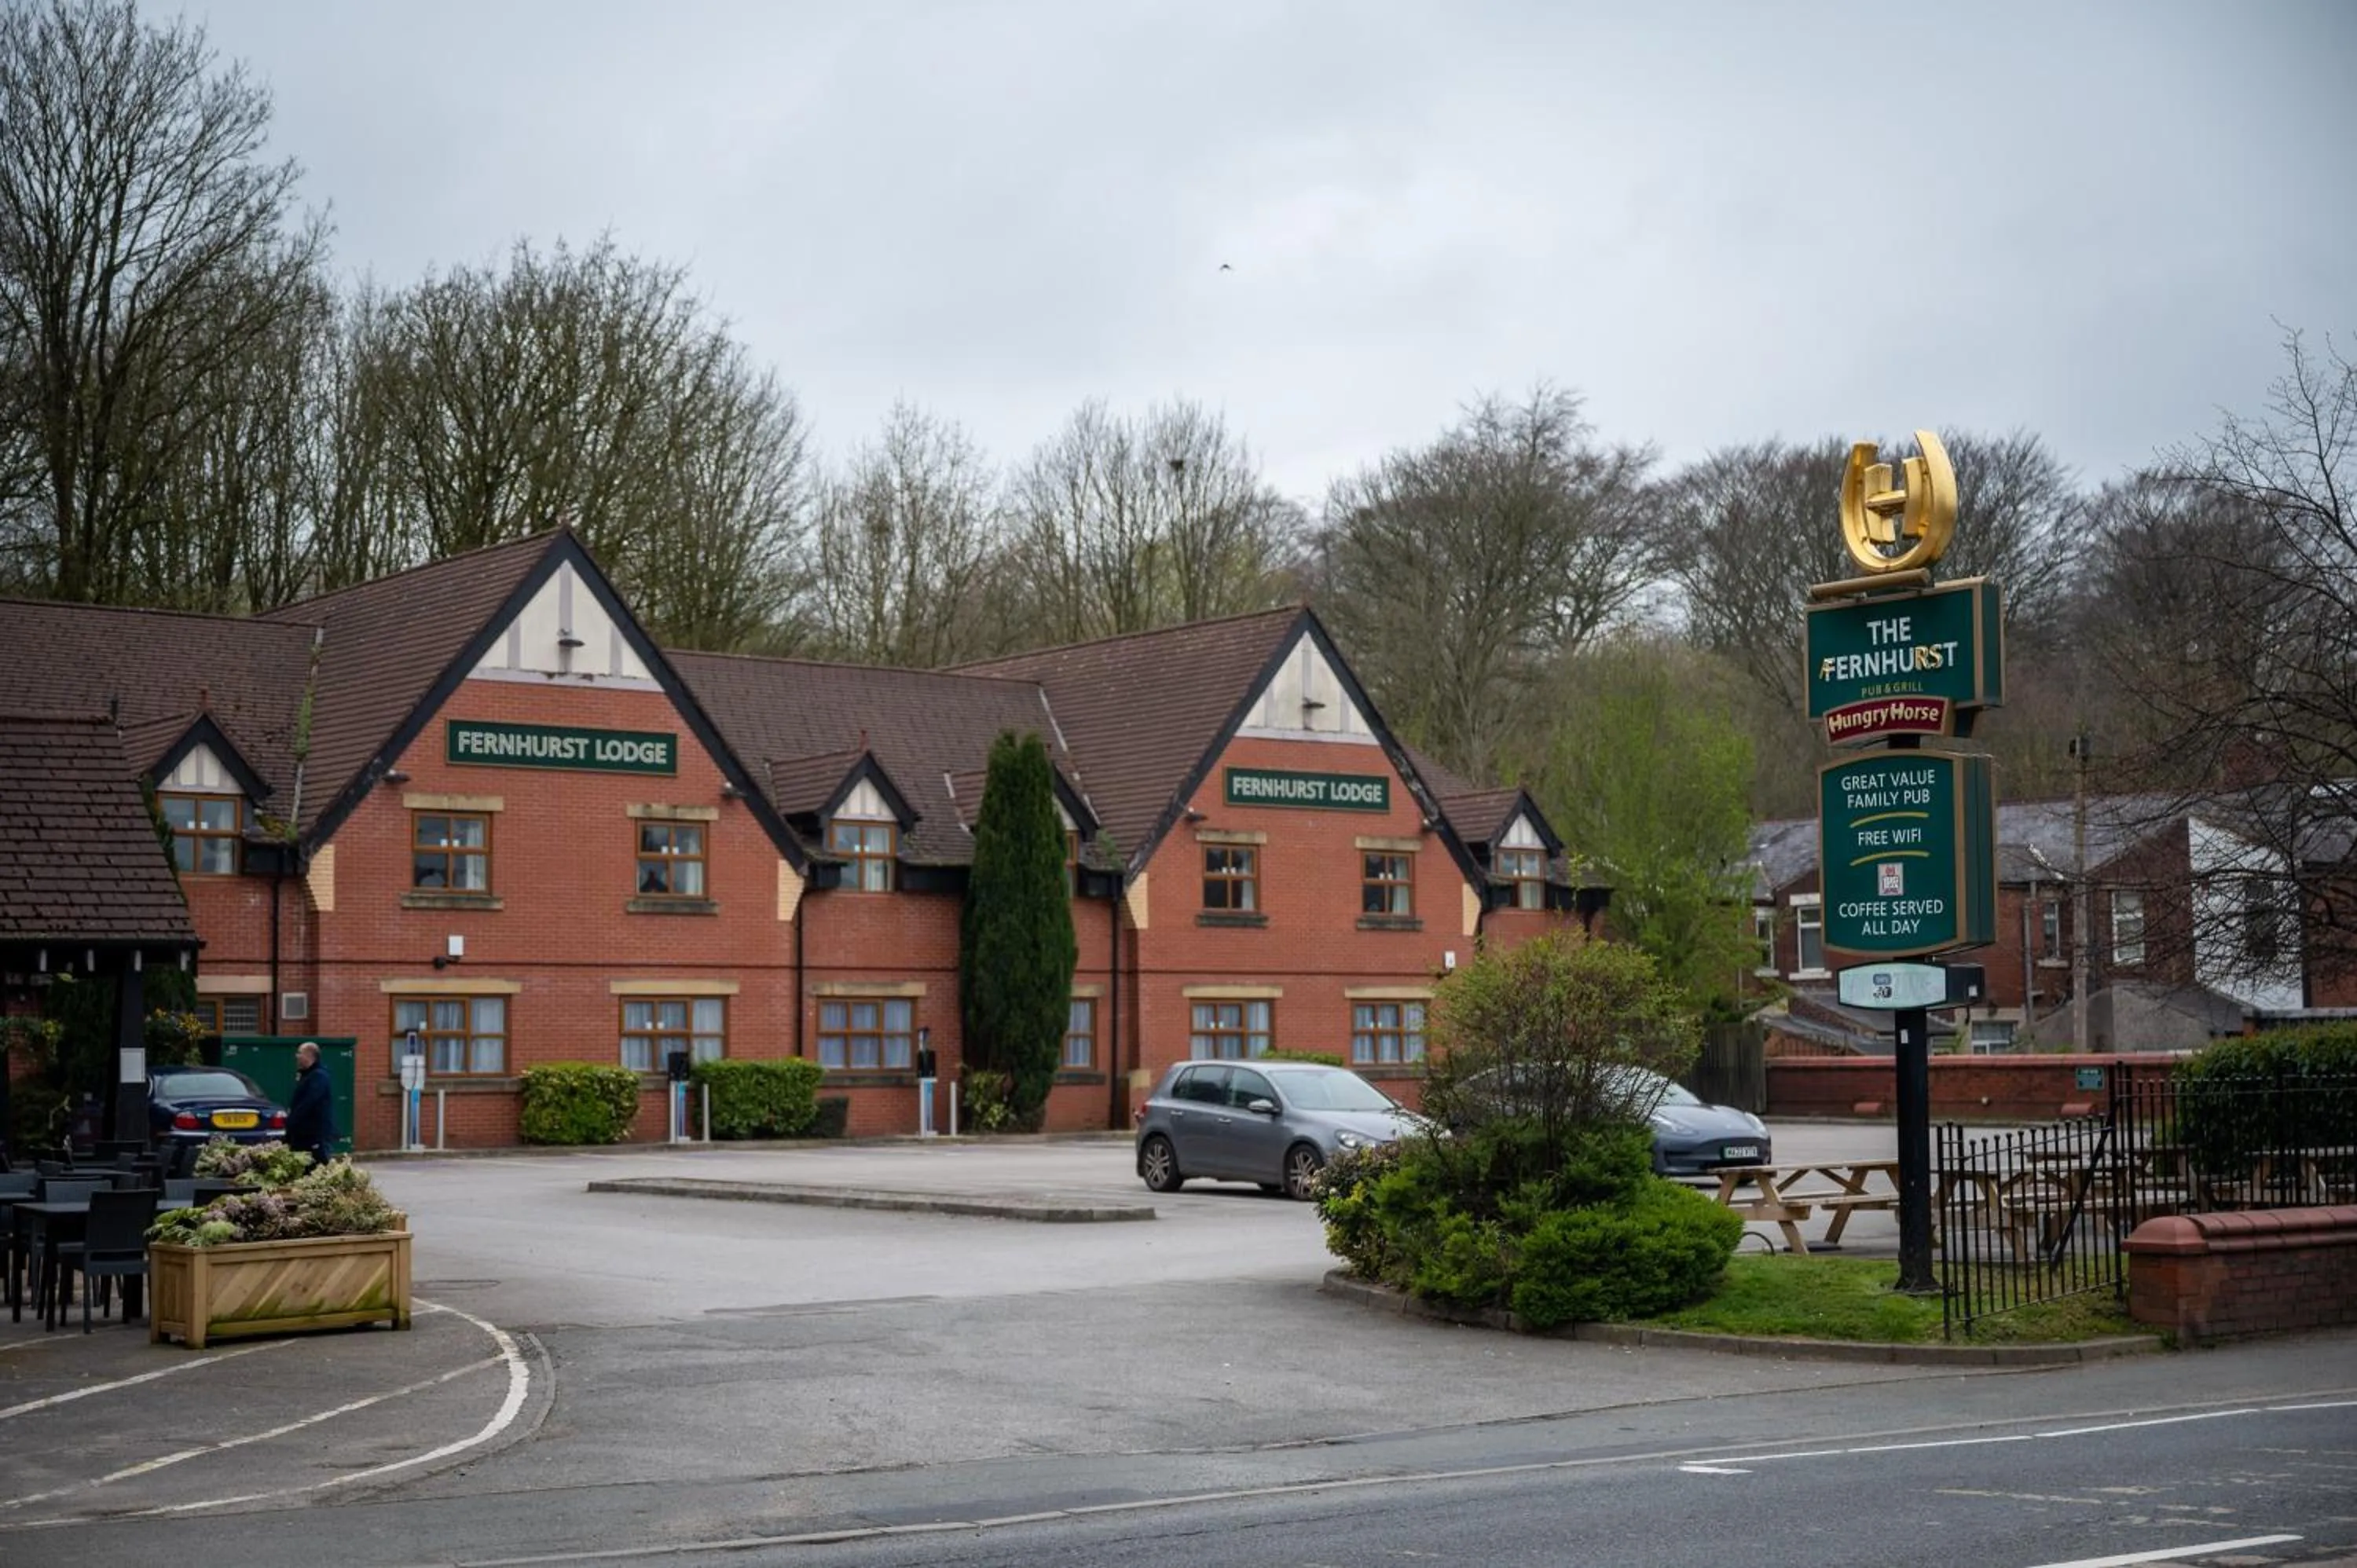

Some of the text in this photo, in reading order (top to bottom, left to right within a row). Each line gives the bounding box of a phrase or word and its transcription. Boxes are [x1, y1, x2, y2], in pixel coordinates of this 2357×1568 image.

[1866, 616, 1912, 646] THE
[1822, 641, 1959, 682] FERNHURST
[1861, 684, 1882, 698] PUB
[1893, 681, 1924, 693] GRILL
[457, 731, 668, 764] FERNHURST LODGE
[1232, 775, 1383, 803] FERNHURST LODGE
[1841, 769, 1935, 791] GREAT VALUE
[1847, 788, 1930, 808] FAMILY PUB
[1858, 828, 1921, 846] FREE WIFI
[1838, 899, 1944, 918] COFFEE SERVED
[1861, 918, 1921, 936] ALL DAY
